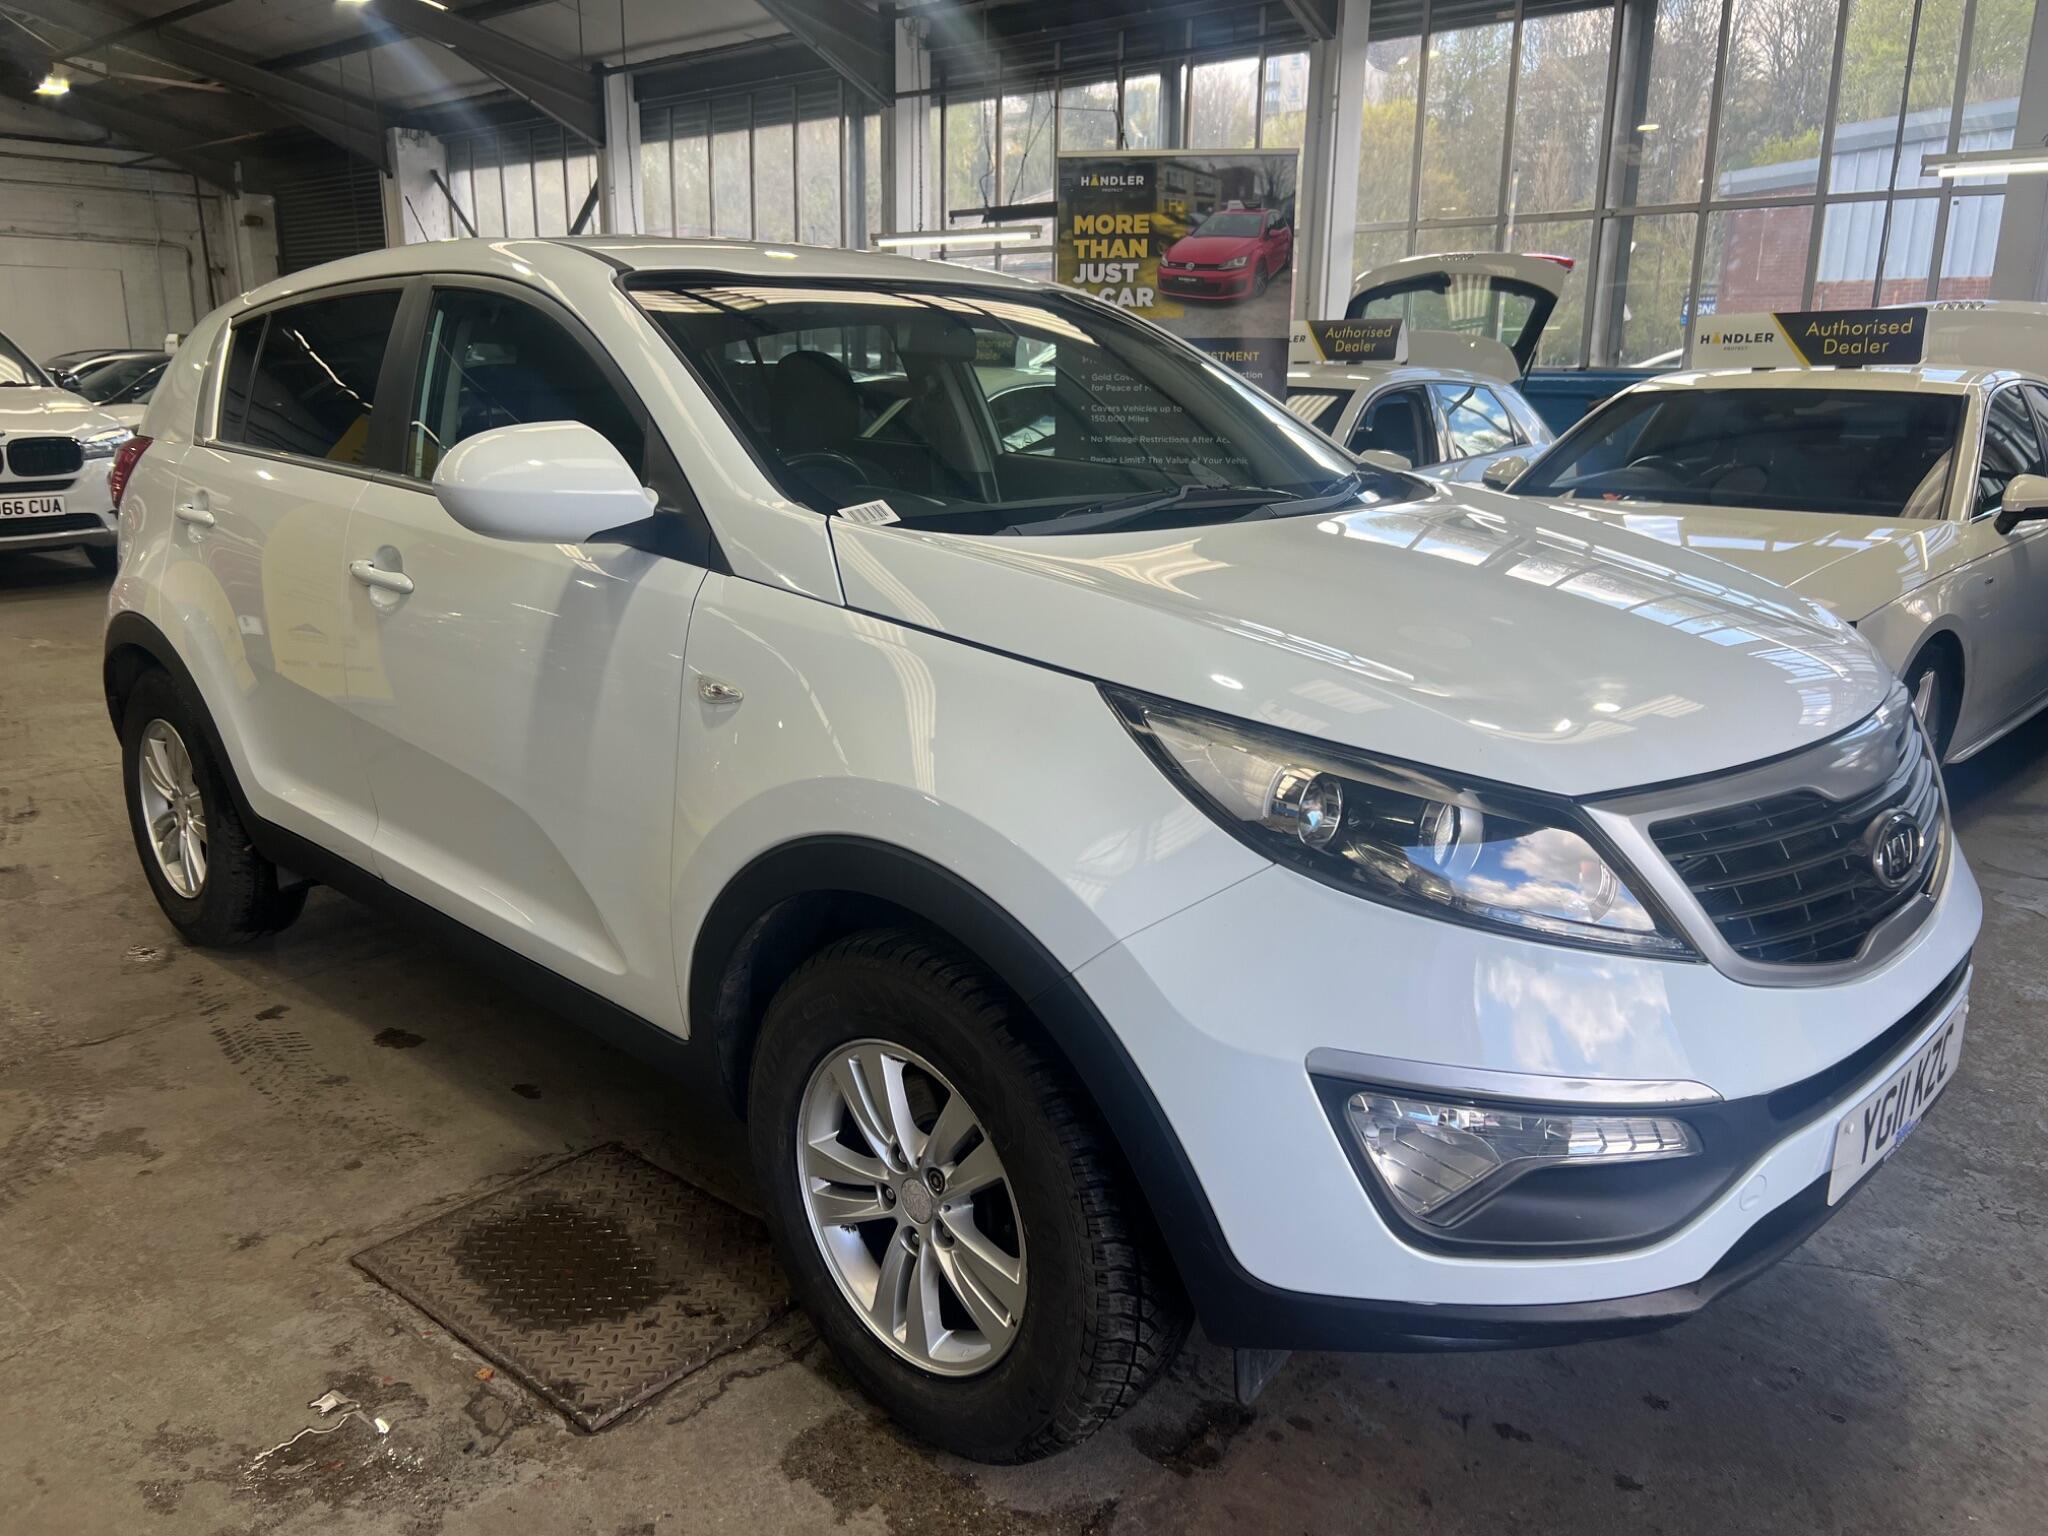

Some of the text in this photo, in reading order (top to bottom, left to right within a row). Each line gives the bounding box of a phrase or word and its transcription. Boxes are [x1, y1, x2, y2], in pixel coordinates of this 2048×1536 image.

[1074, 214, 1150, 235] MORE
[1073, 238, 1148, 259] THAN
[1073, 263, 1139, 284] JUST
[1099, 287, 1154, 307] CAR
[1325, 325, 1393, 339] Authorised
[1805, 316, 1914, 337] Authorised
[1335, 340, 1377, 353] Dealer
[1823, 337, 1889, 355] Dealer
[1206, 351, 1260, 362] STMENT
[1091, 373, 1112, 381] Gold
[1239, 370, 1263, 379] ction
[1091, 384, 1104, 392] for
[1105, 384, 1131, 392] Peace
[1133, 384, 1142, 392] of
[1091, 404, 1182, 413] Covers Vehicles up to
[1128, 415, 1150, 423] Miles
[1139, 436, 1190, 444] Restrictions
[1119, 456, 1146, 464] Limit?
[1147, 456, 1163, 464] The
[1165, 456, 1188, 464] Value
[1202, 456, 1223, 465] Your
[1224, 457, 1249, 465] Vehic
[0, 498, 62, 515] 66 CUA
[1861, 1069, 1912, 1165] YG11
[1909, 1023, 1954, 1116] KZC
